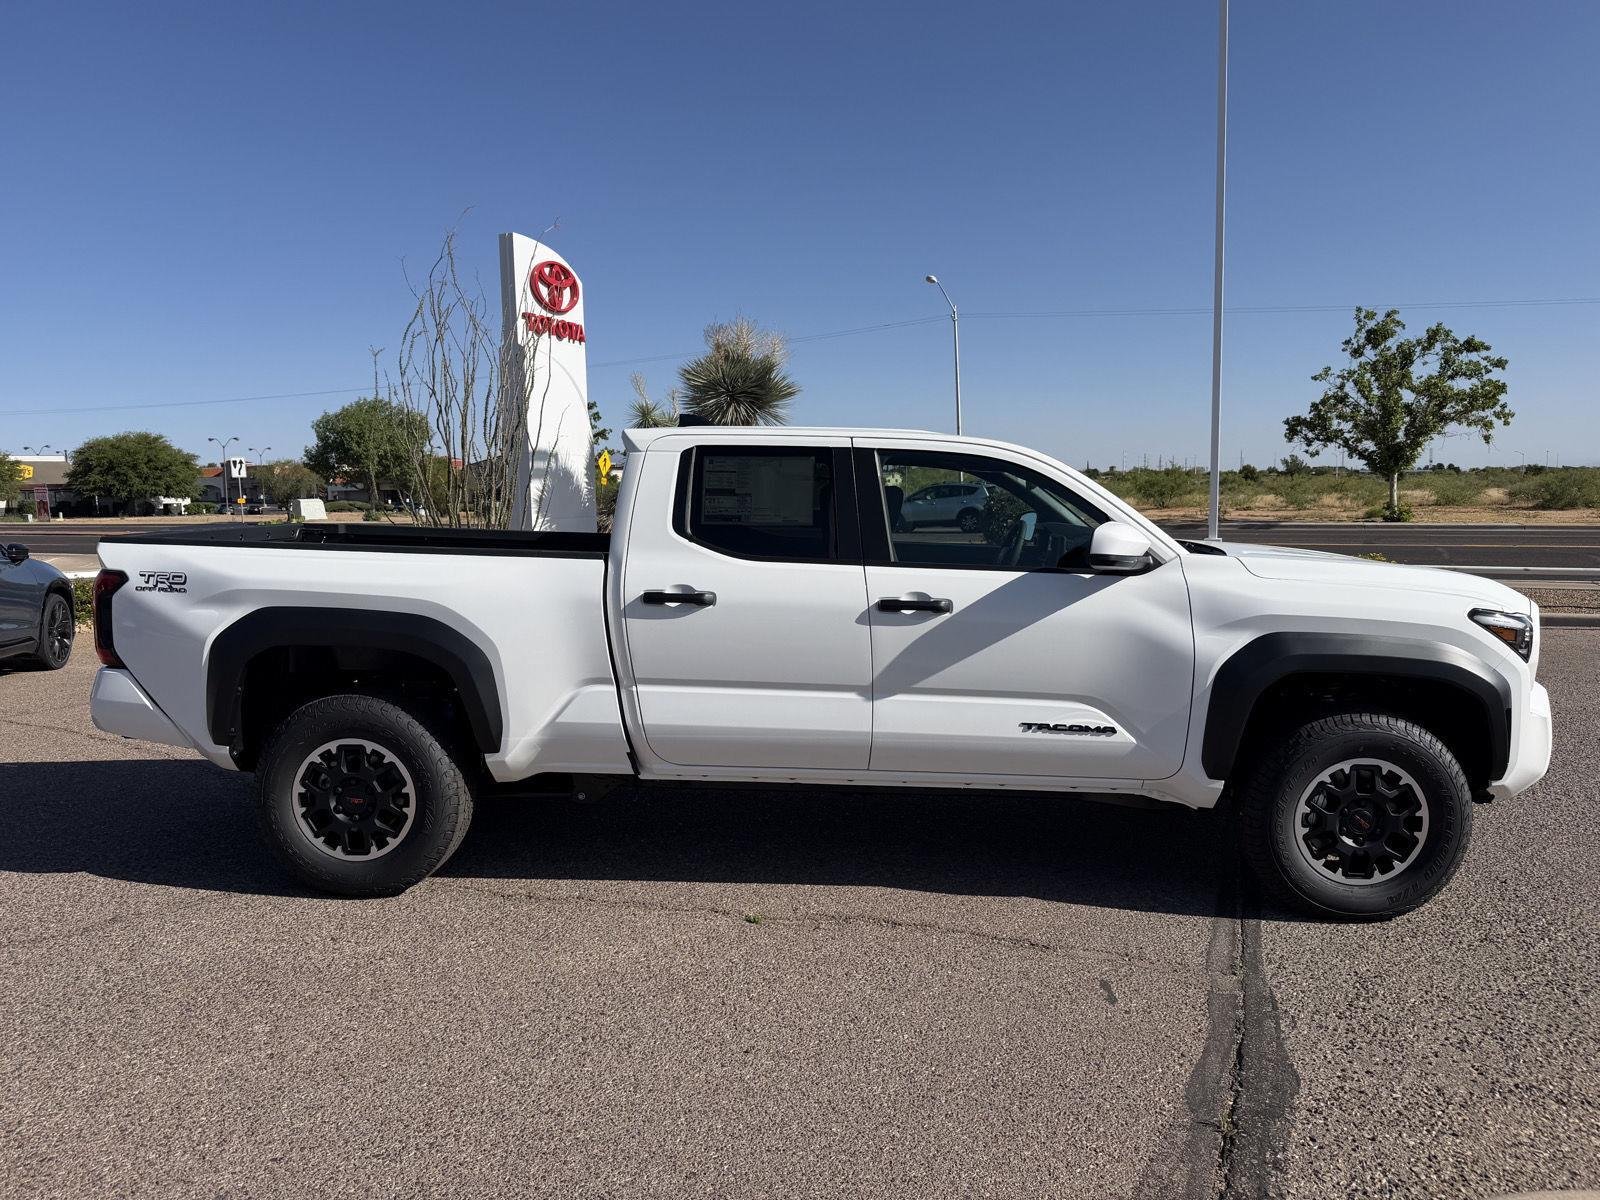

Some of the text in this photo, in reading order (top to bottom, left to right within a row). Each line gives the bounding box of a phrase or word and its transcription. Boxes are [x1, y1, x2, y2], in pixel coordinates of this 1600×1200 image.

[521, 312, 586, 344] TOYOTA
[139, 570, 187, 588] TRD
[1019, 722, 1118, 735] TACOMA
